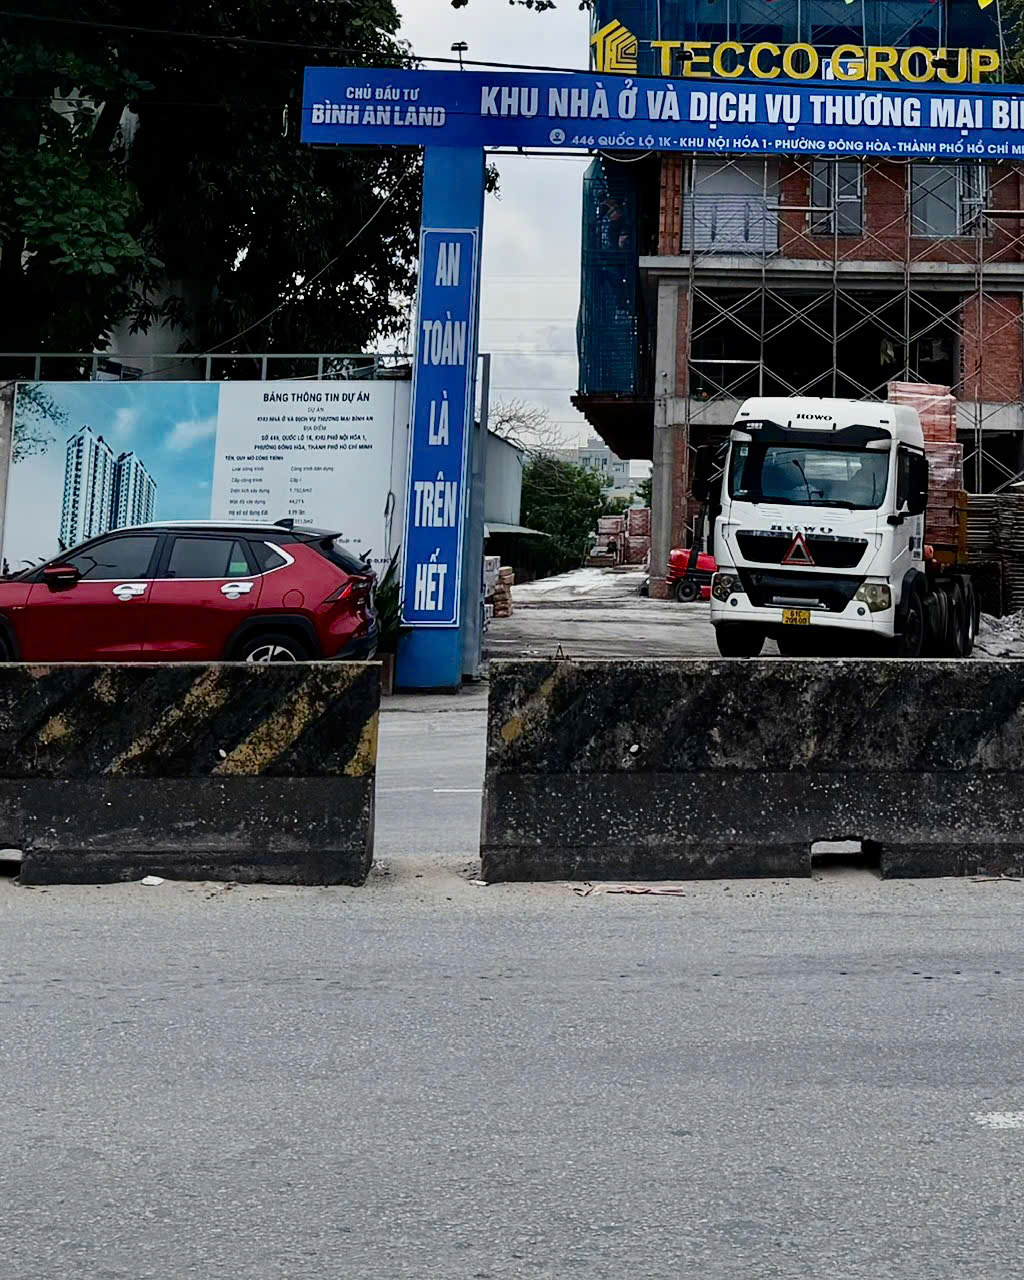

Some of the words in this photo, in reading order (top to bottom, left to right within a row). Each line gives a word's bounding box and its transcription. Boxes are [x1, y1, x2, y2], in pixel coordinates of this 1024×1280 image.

[650, 40, 818, 80] TECCO
[831, 44, 999, 84] GROUP
[312, 100, 360, 124] BÌNH
[362, 105, 391, 125] AN
[394, 106, 446, 127] LAND
[346, 83, 372, 100] CHỦ
[403, 88, 420, 101] TƯ
[481, 86, 539, 117] KHU
[548, 82, 609, 119] NHÀ
[618, 78, 638, 119] Ở
[647, 84, 680, 121] VÀ
[689, 91, 756, 129] DỊCH
[766, 94, 800, 131] VỤ
[810, 92, 921, 128] THƯƠNG
[929, 99, 983, 136] MẠI
[571, 136, 594, 146] 446
[598, 131, 635, 146] QUỐC
[639, 135, 654, 148] LỘ
[658, 137, 671, 146] 1K
[680, 138, 704, 148] KHU
[707, 135, 730, 150] NỘI
[733, 135, 759, 148] HÓA
[775, 136, 825, 150] PHƯỜNG
[828, 138, 863, 151] ĐÔNG
[939, 138, 963, 153] PHỐ
[967, 139, 985, 154] HỒ
[988, 140, 1009, 154] CHÍ
[435, 242, 461, 287] AN
[423, 311, 466, 366] TOÀN
[263, 391, 289, 403] BẢNG
[291, 391, 322, 403] THÔNG
[325, 392, 340, 403] TIN
[341, 392, 356, 404] DỰ
[356, 391, 370, 402] ÁN
[428, 390, 449, 445] LÀ
[796, 413, 833, 421] HOWO
[414, 471, 458, 528] TRÊN
[414, 547, 448, 611] HẾT
